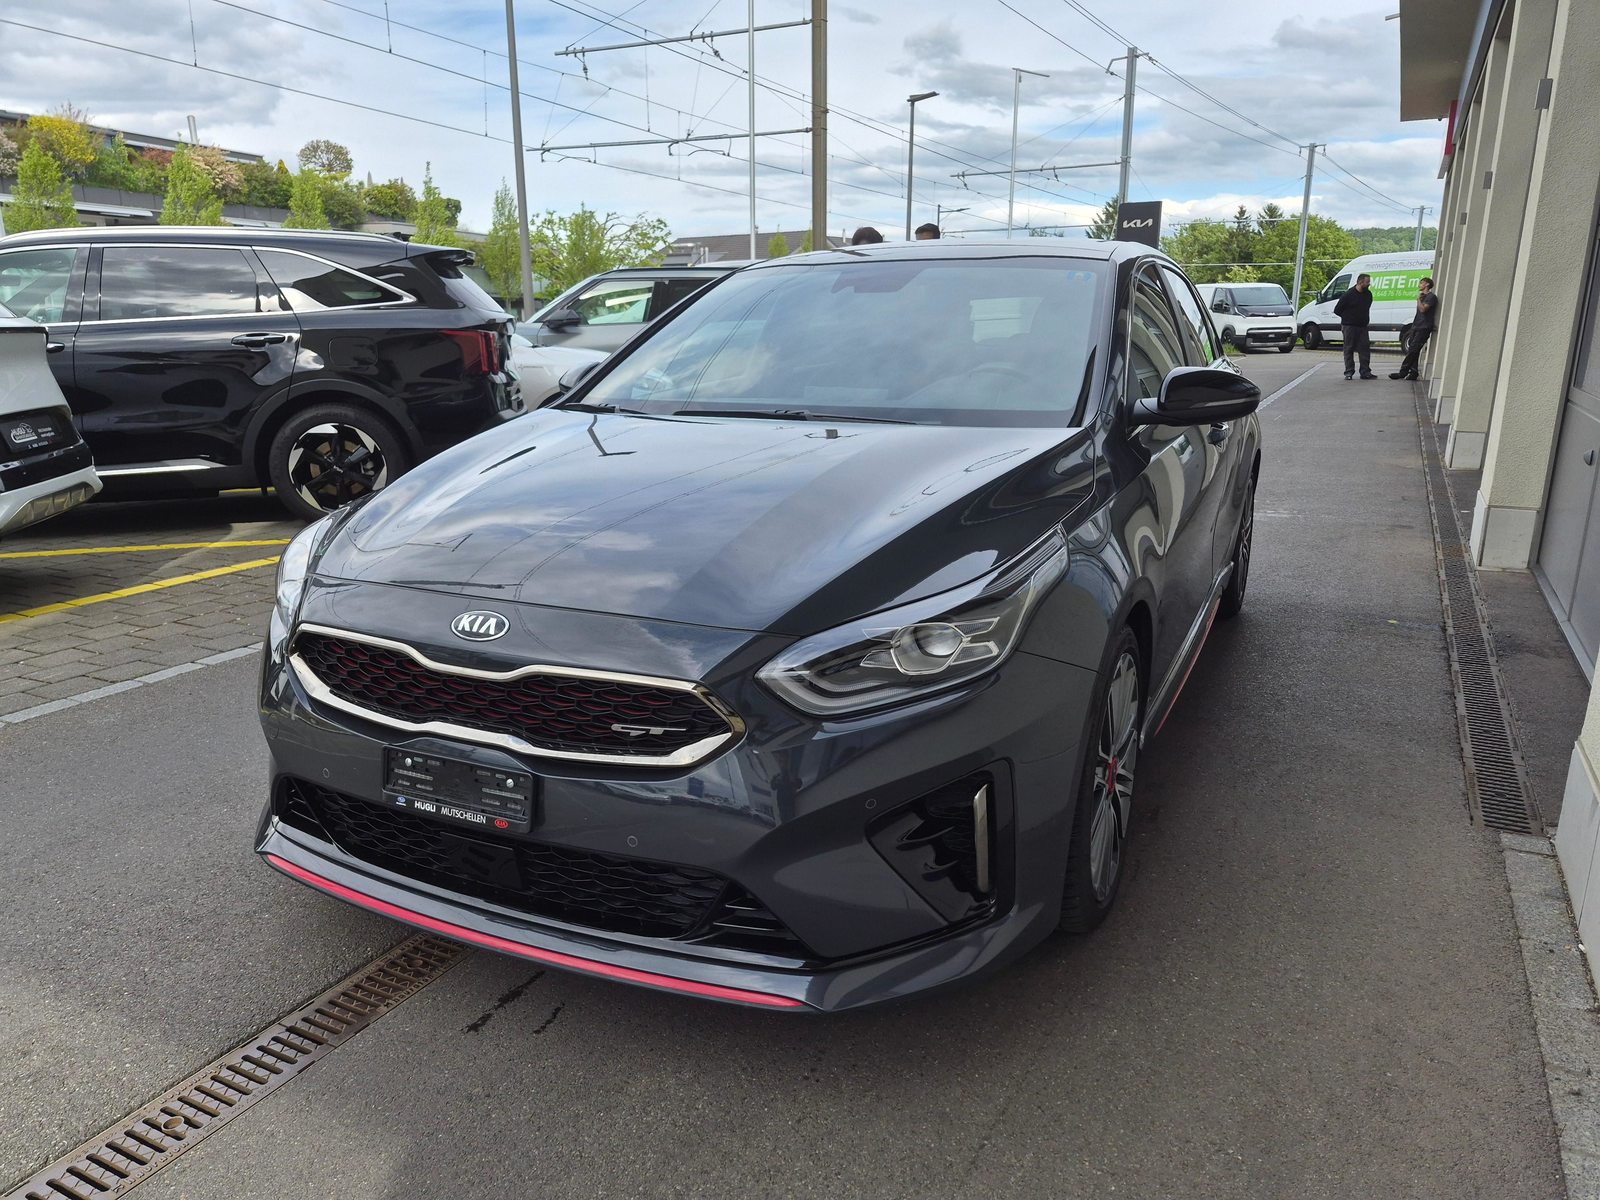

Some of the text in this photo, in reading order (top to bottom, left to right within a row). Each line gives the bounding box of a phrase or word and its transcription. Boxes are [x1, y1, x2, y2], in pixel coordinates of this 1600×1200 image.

[1122, 218, 1153, 228] KIA
[1370, 275, 1406, 289] MIETE
[457, 612, 496, 635] KIA
[611, 723, 687, 736] GT
[440, 806, 487, 824] MUTSCHELLEN
